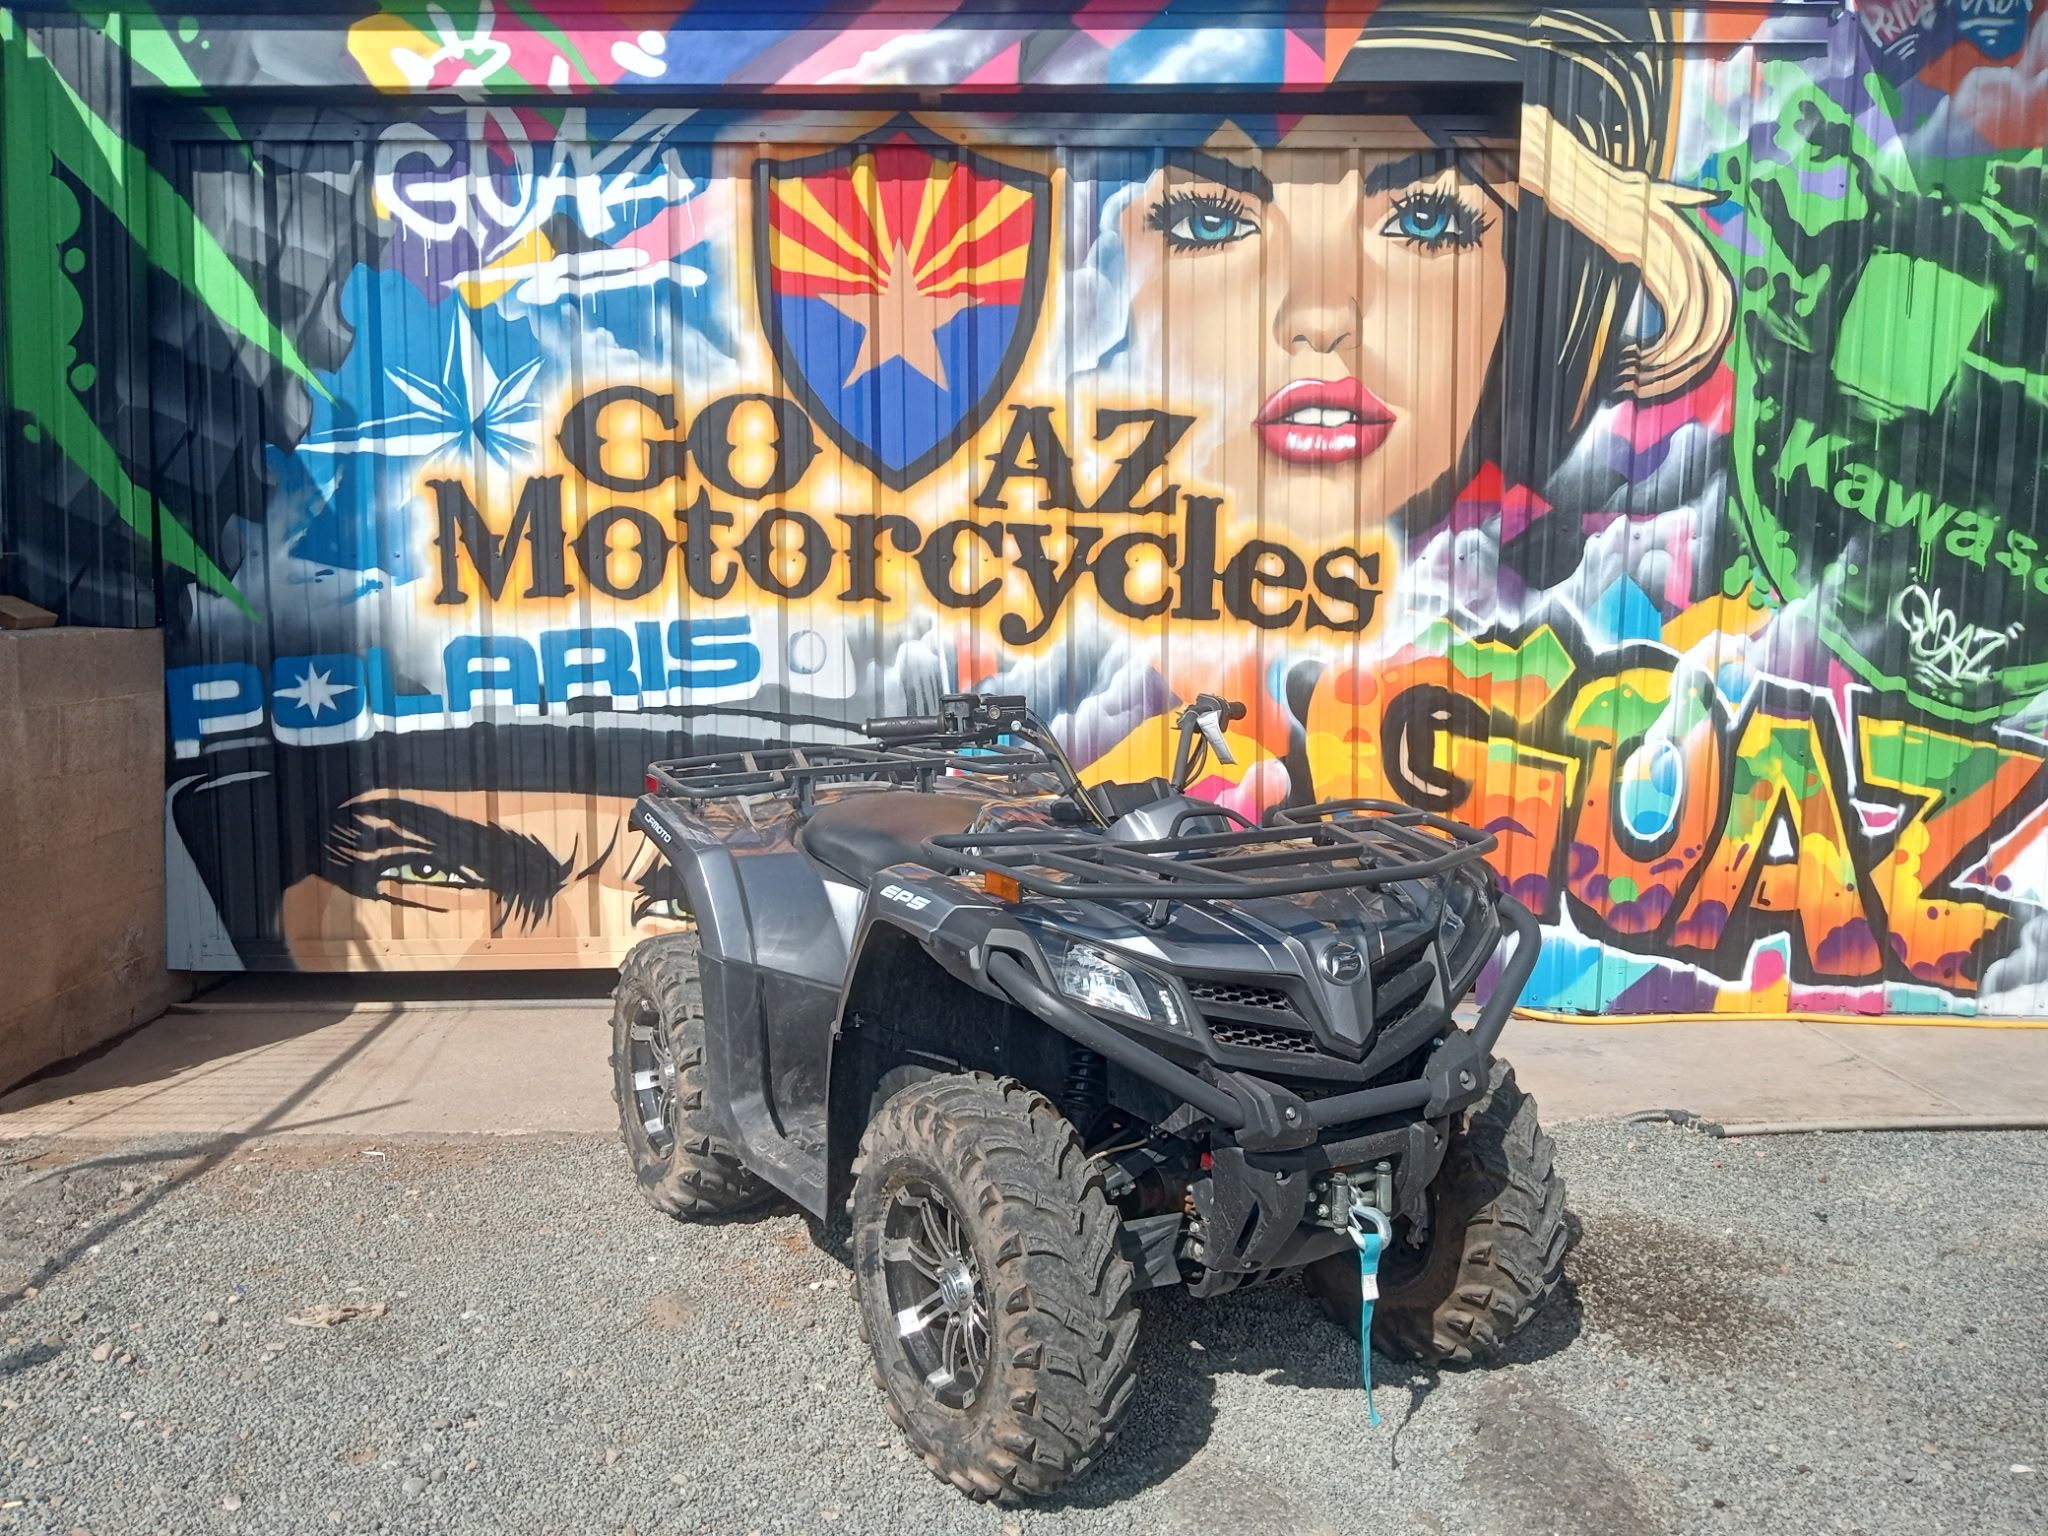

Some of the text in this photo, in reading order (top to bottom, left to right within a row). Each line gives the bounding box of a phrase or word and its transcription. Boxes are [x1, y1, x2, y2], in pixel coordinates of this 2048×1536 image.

[556, 385, 1196, 515] GO AZ
[424, 474, 1384, 646] Motorcycles
[165, 615, 761, 758] POLARIS
[644, 812, 672, 843] CFMOTO
[880, 884, 932, 911] EPS
